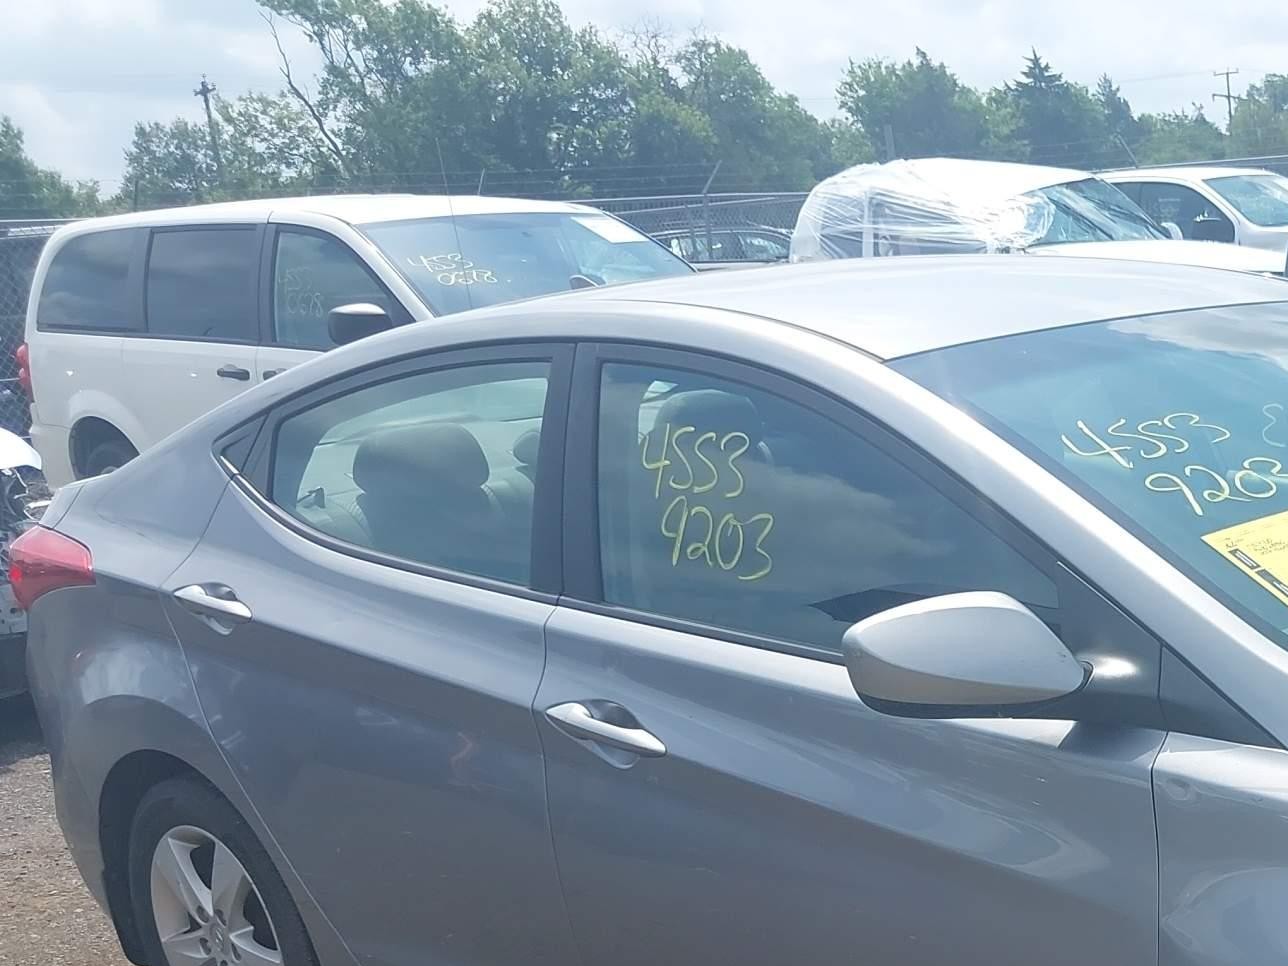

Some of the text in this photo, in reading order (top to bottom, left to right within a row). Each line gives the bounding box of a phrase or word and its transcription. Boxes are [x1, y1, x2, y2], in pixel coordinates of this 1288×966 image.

[641, 422, 750, 499] 4553
[1061, 412, 1232, 469] 4553
[660, 495, 775, 581] 9203
